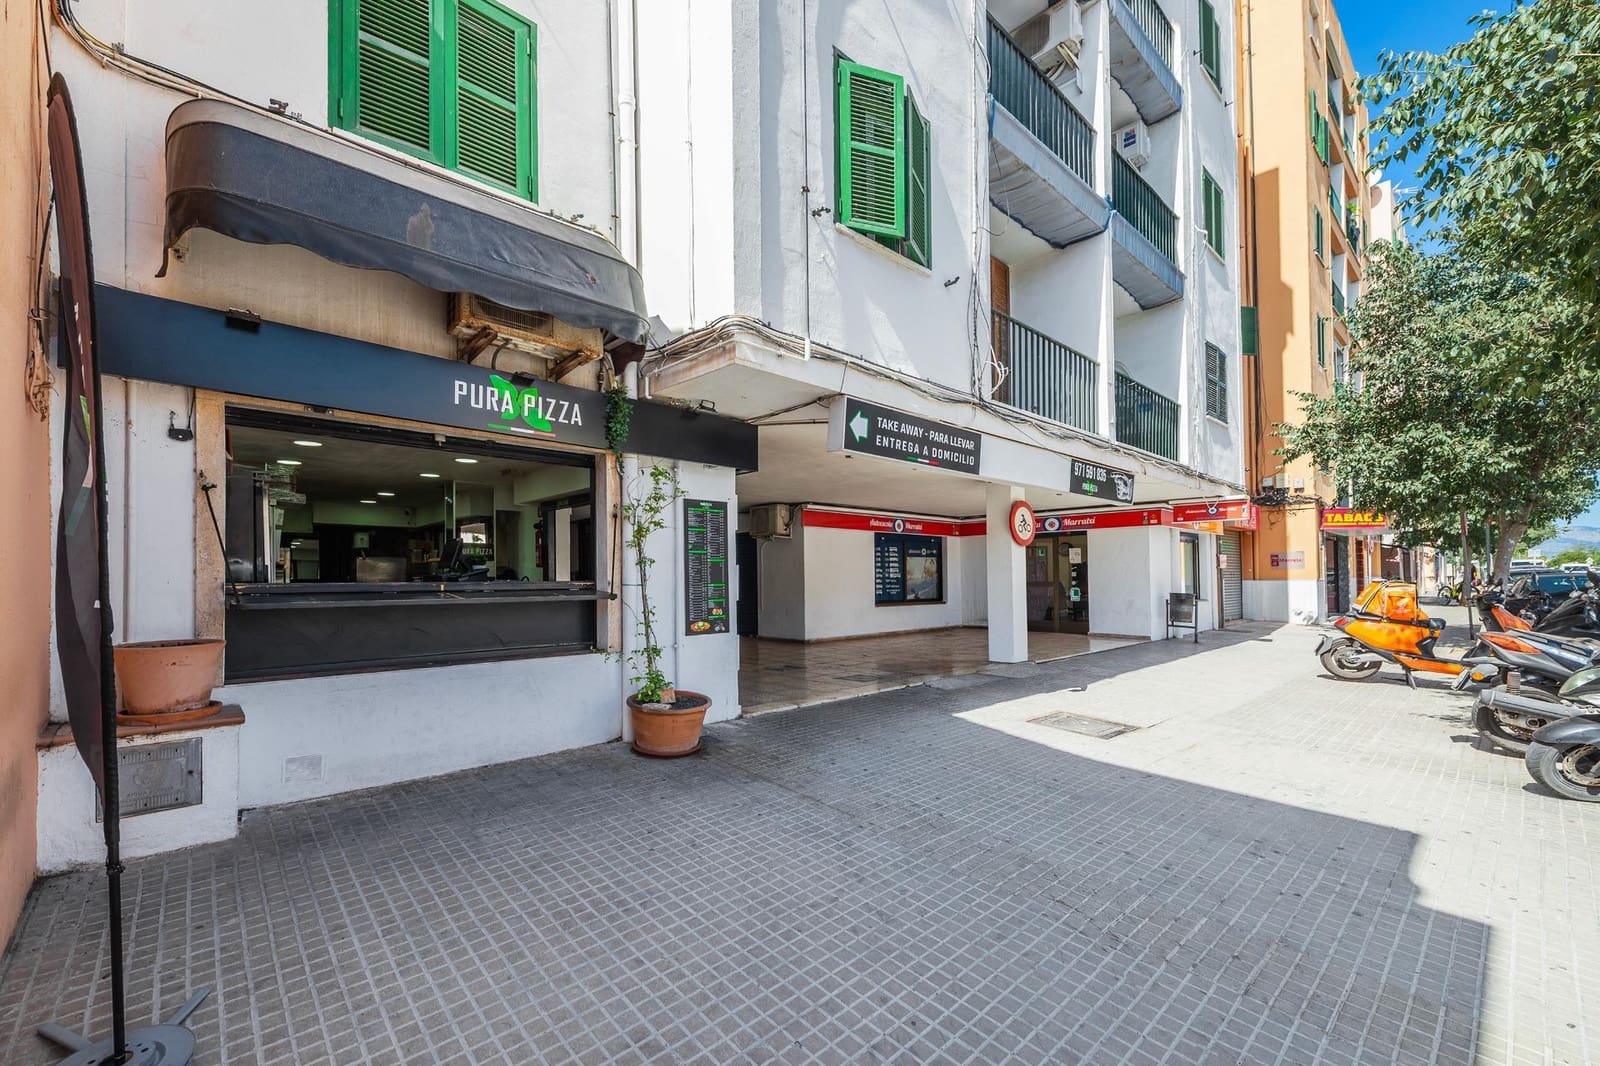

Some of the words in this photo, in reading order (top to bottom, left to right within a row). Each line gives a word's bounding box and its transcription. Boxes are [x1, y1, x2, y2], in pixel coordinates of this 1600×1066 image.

[454, 380, 514, 414] PURA
[523, 393, 583, 426] PIZZA
[876, 417, 899, 432] TAKE
[900, 423, 924, 438] AWAY
[929, 430, 949, 444] PARA
[950, 436, 975, 451] LLEVAR
[876, 435, 919, 454] ENTREGA
[923, 447, 929, 456] A
[932, 448, 975, 466] DOMICILIO
